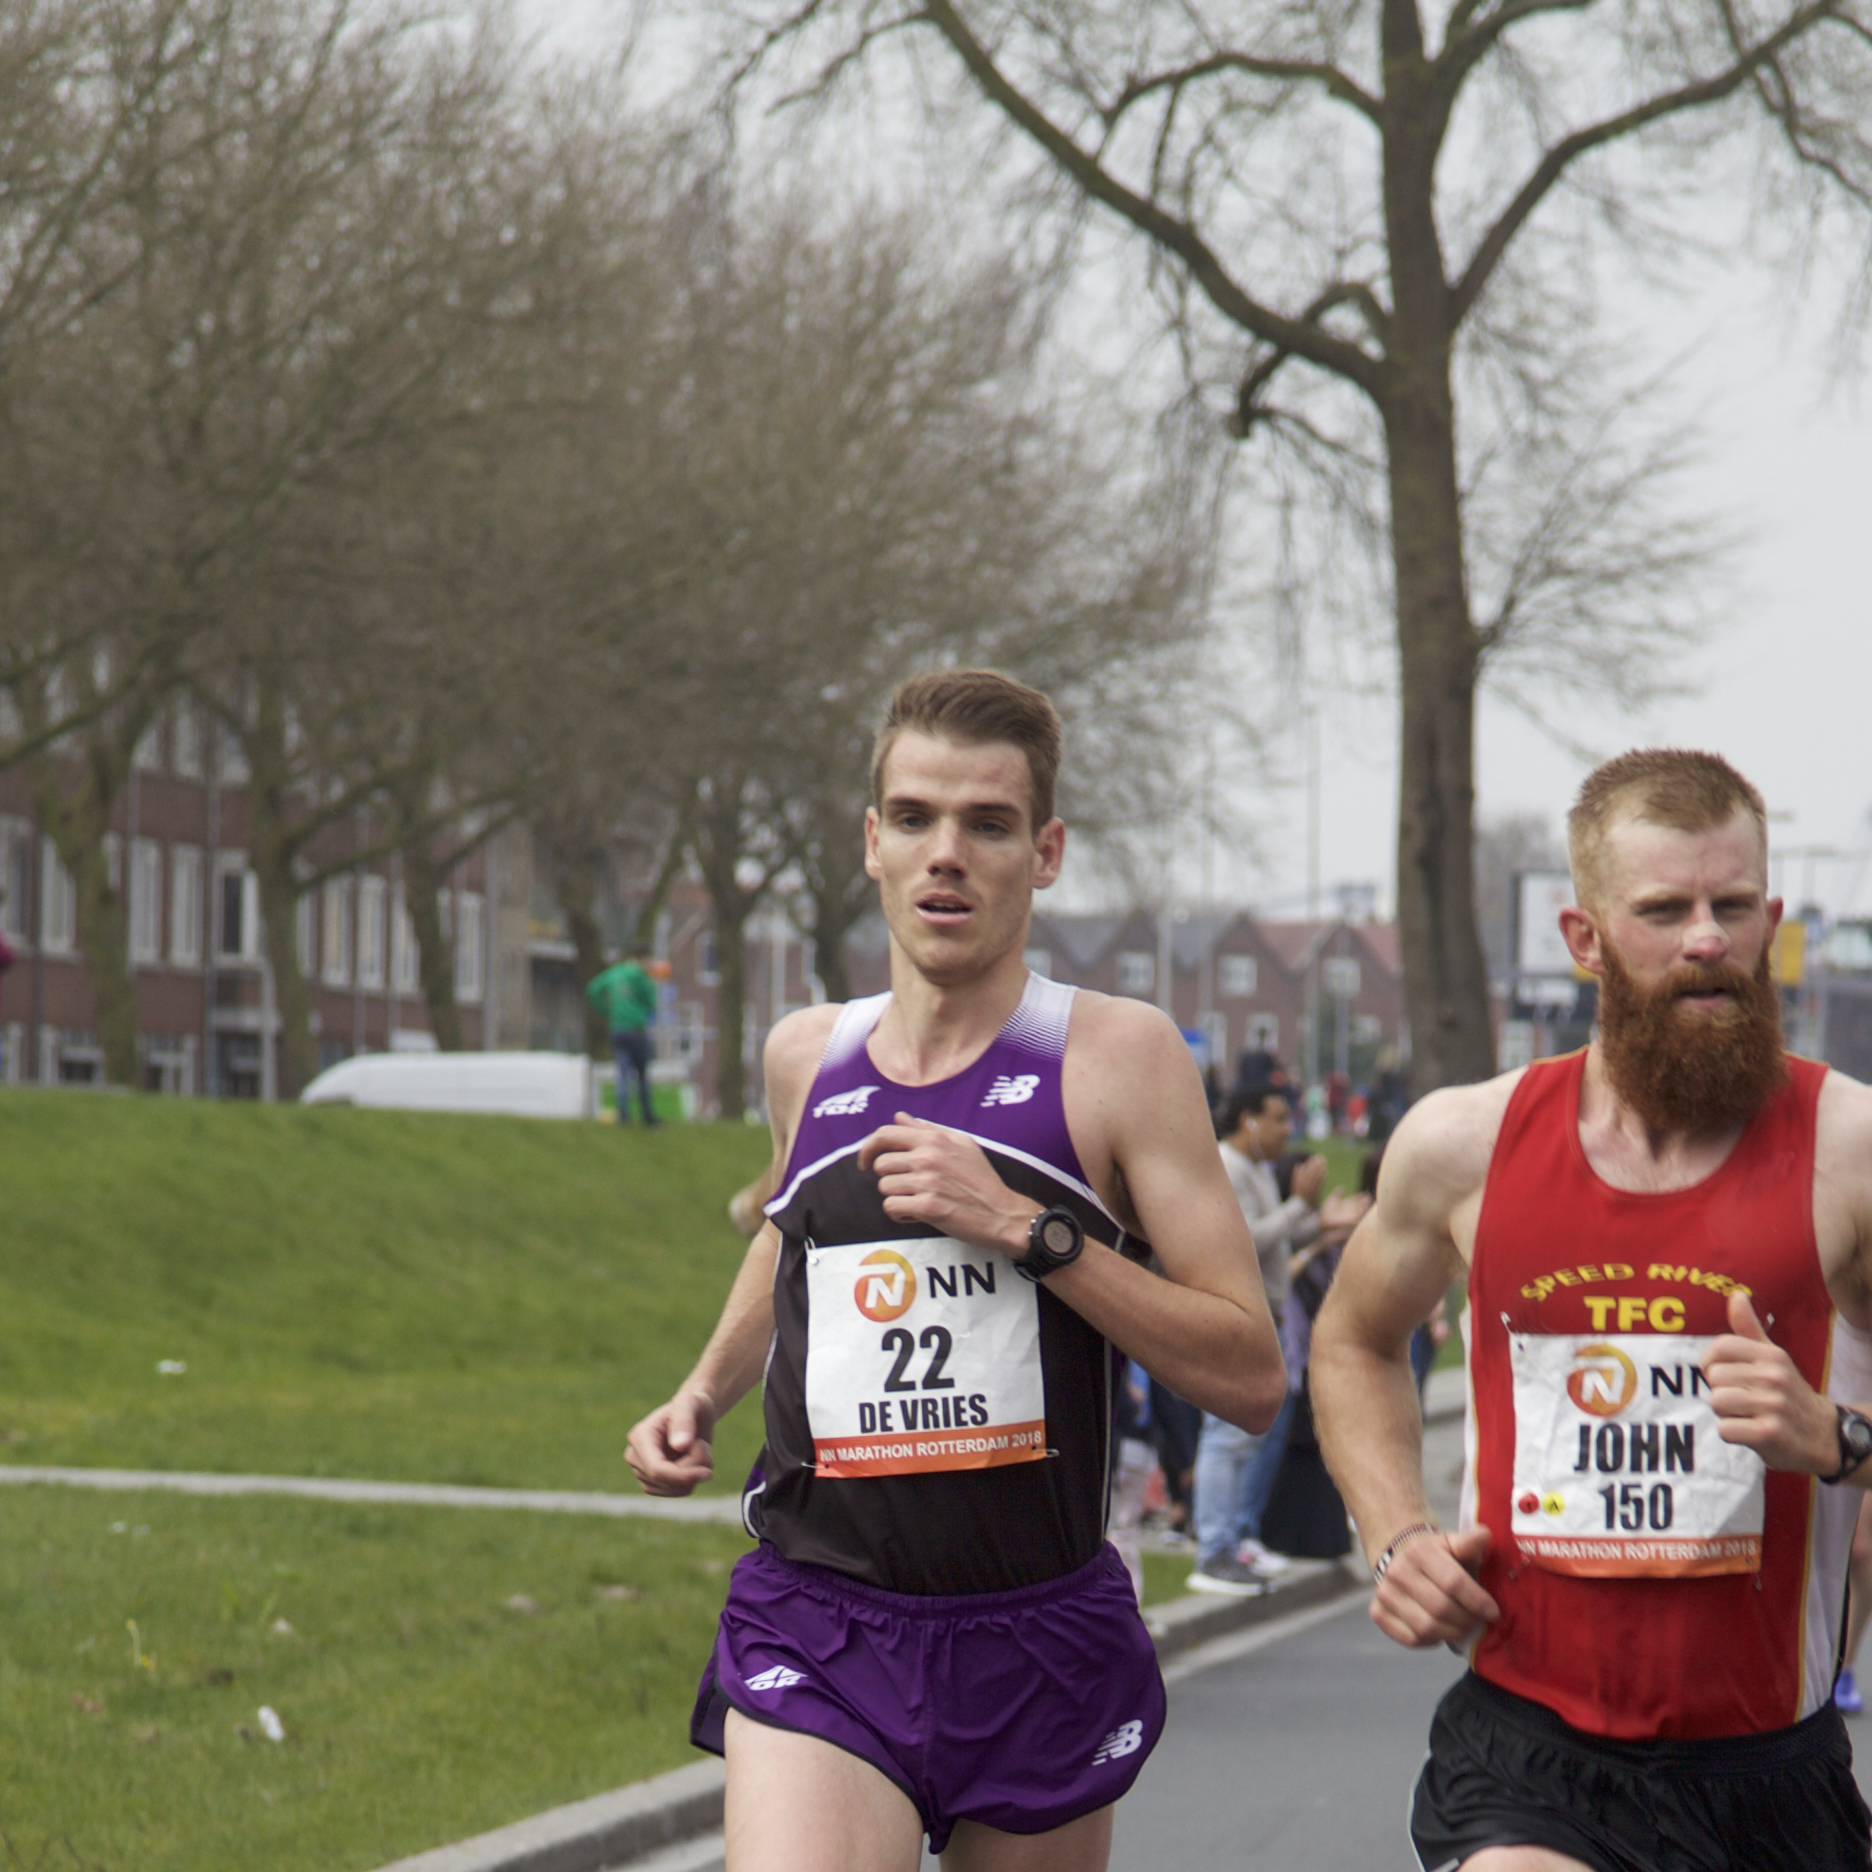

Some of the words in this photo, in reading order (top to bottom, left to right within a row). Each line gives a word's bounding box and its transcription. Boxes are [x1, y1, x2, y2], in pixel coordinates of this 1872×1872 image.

[926, 1261, 996, 1298] NN
[1520, 1263, 1635, 1302] SPEED
[1583, 1295, 1686, 1332] TFC
[881, 1325, 955, 1392] 22
[859, 1401, 894, 1434] DE
[900, 1393, 989, 1431] VRIES
[819, 1448, 837, 1462] NN
[837, 1443, 913, 1461] MARATHON
[916, 1435, 1009, 1457] ROTTERDAM
[1012, 1430, 1042, 1447] 2018
[1573, 1422, 1694, 1473] JOHN
[1598, 1482, 1673, 1530] 150
[1538, 1540, 1622, 1560] MARATHON
[1625, 1541, 1722, 1560] ROTTERDAM
[1724, 1541, 1757, 1556] 2018
